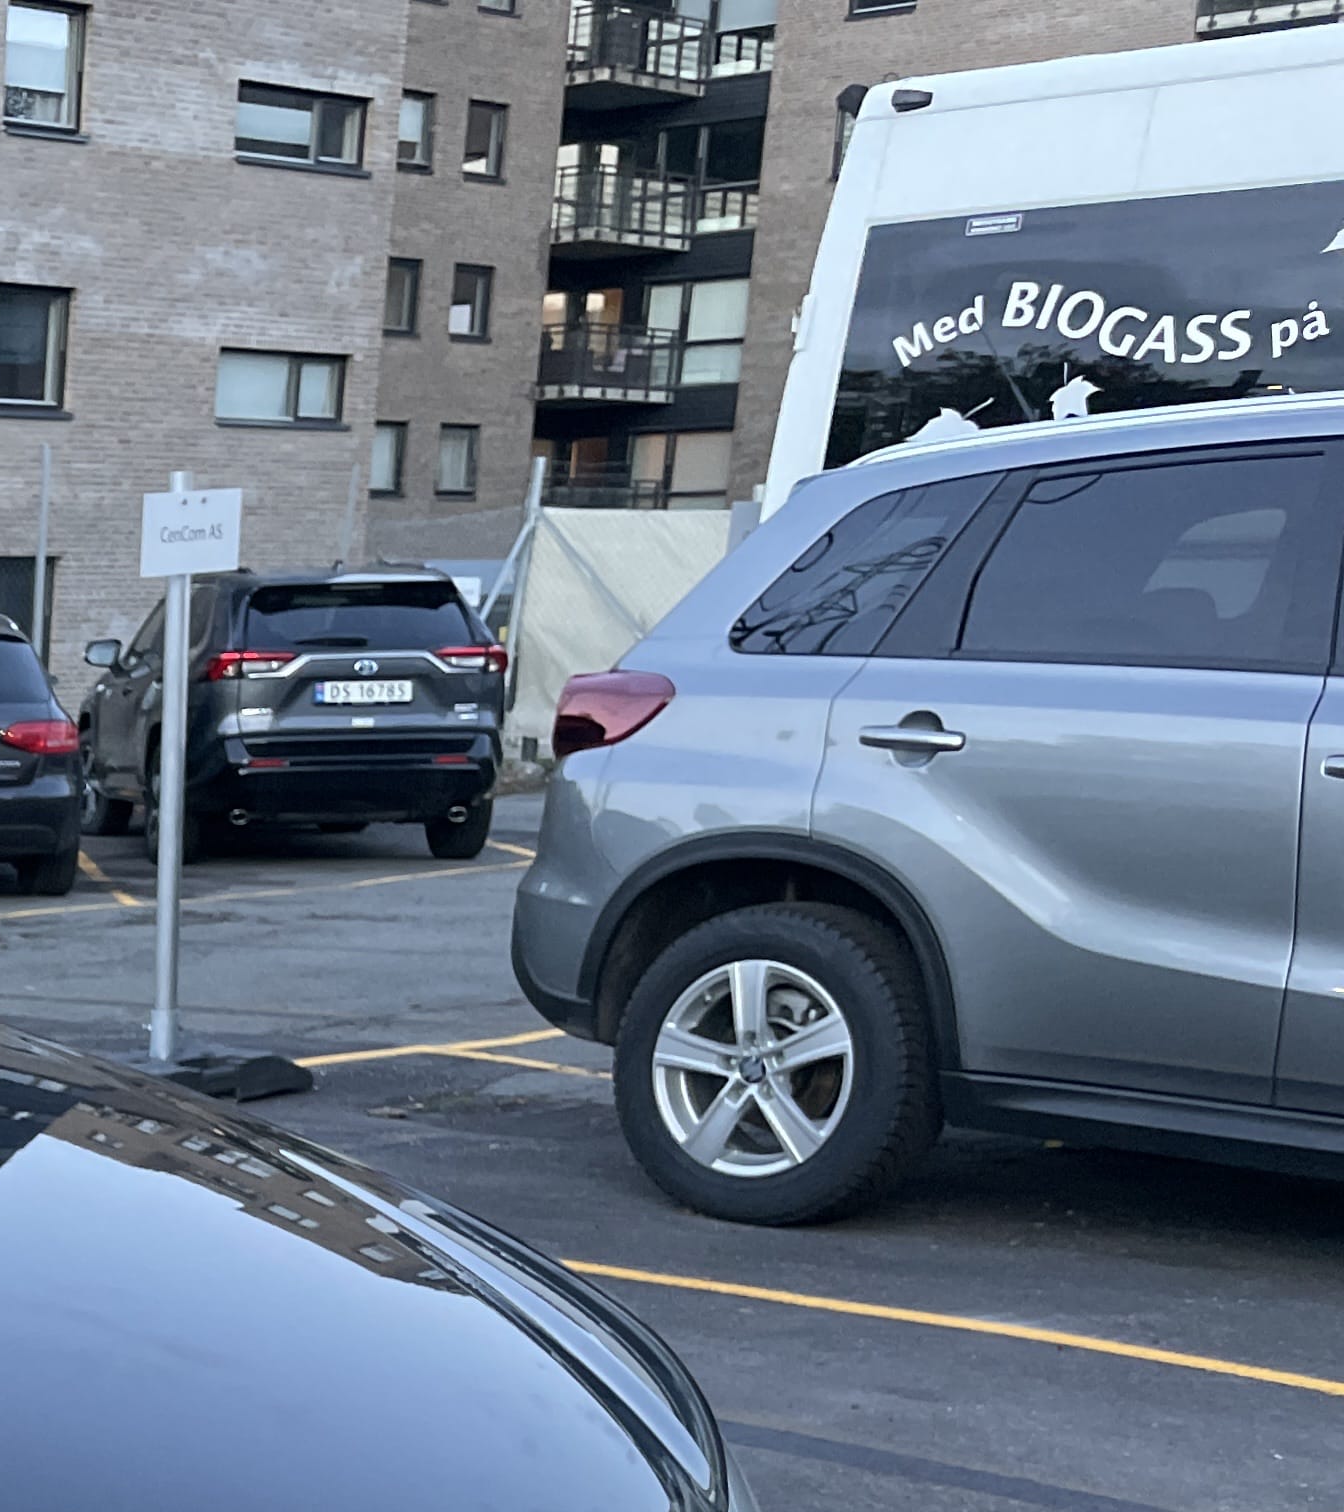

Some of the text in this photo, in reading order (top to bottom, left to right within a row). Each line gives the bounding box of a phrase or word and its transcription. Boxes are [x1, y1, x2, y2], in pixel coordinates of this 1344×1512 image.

[890, 281, 1331, 369] Med BIOGASS på
[159, 523, 224, 544] CenCom AS
